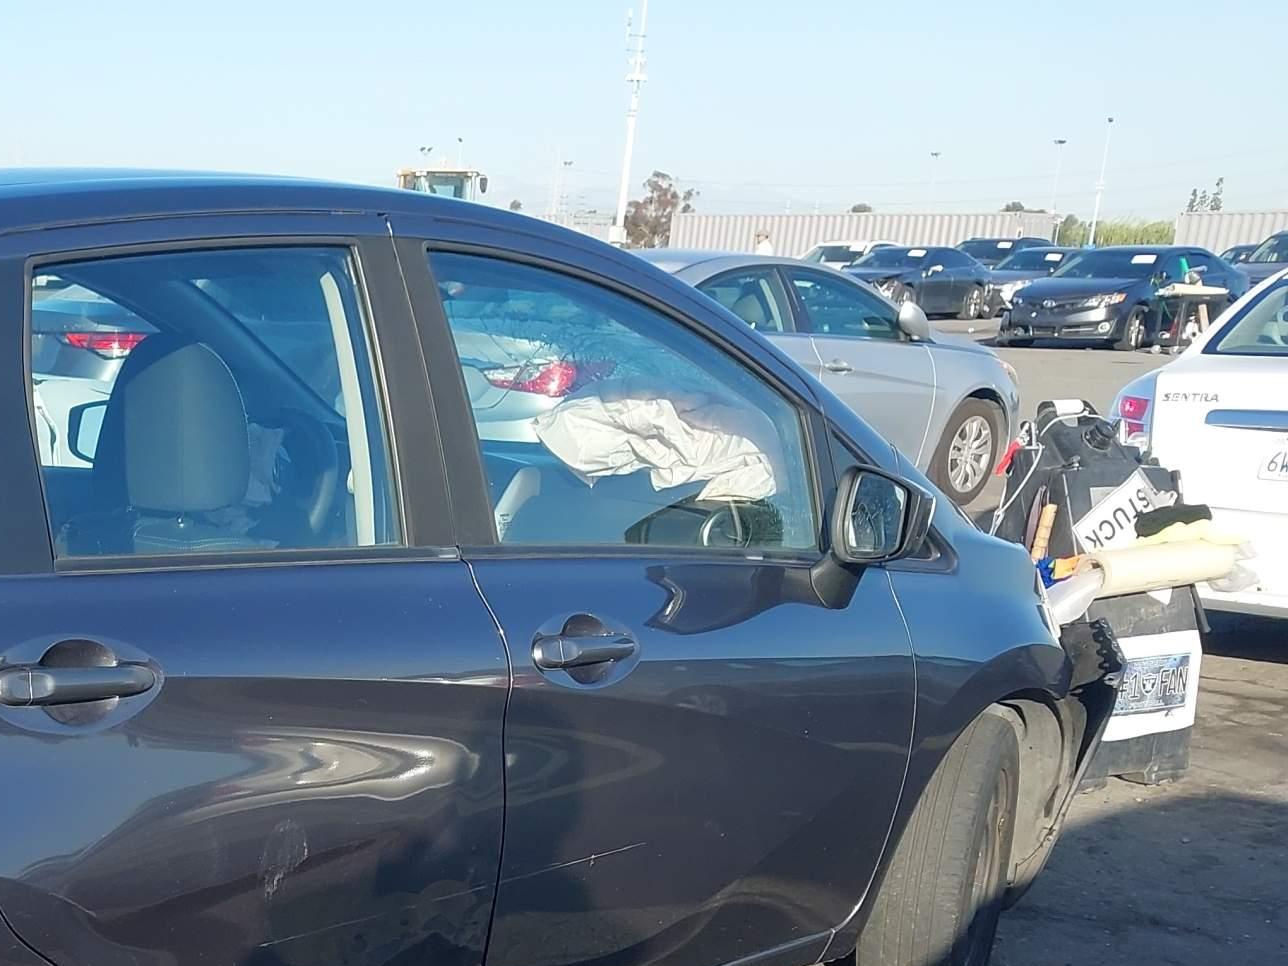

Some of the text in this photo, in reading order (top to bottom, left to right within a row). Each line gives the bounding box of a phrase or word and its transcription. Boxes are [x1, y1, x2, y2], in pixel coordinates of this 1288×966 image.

[1162, 392, 1220, 402] SENTRA
[1085, 488, 1150, 548] STUCK
[1159, 666, 1189, 697] FAN
